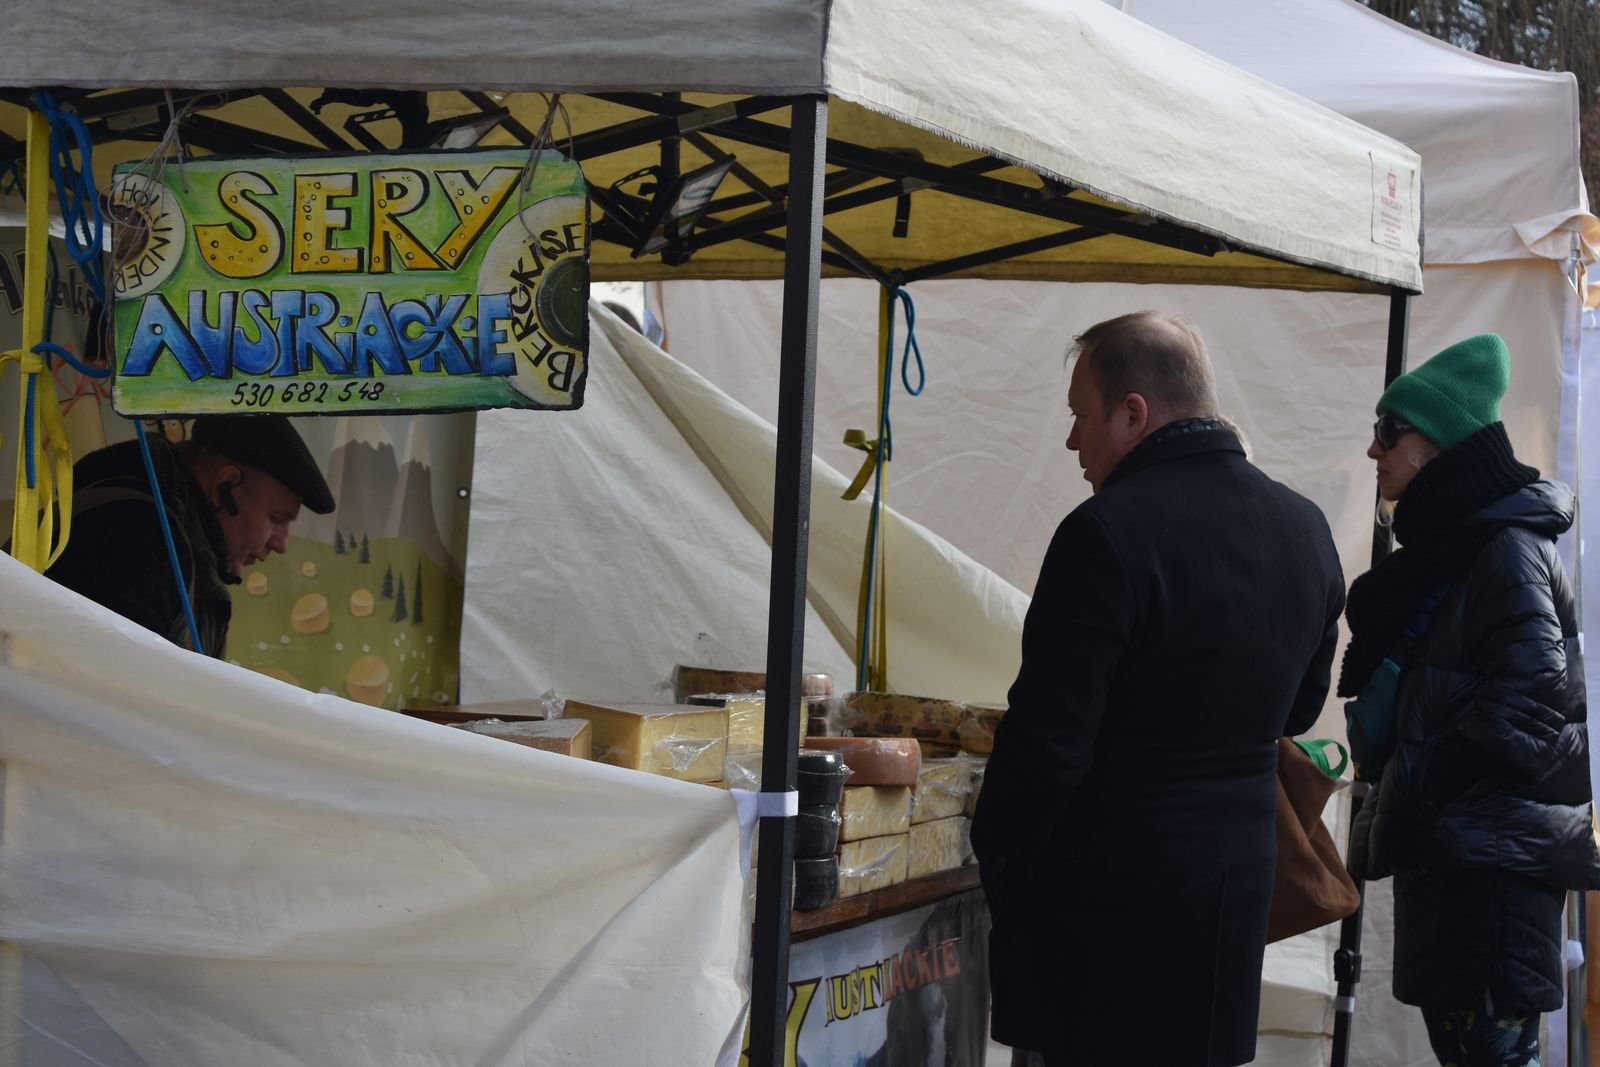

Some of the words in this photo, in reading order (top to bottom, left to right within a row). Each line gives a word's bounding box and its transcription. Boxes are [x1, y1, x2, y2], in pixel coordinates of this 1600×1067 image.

[194, 166, 525, 279] SERY
[231, 383, 275, 407] 530
[281, 382, 327, 404] 682
[338, 382, 384, 402] 548
